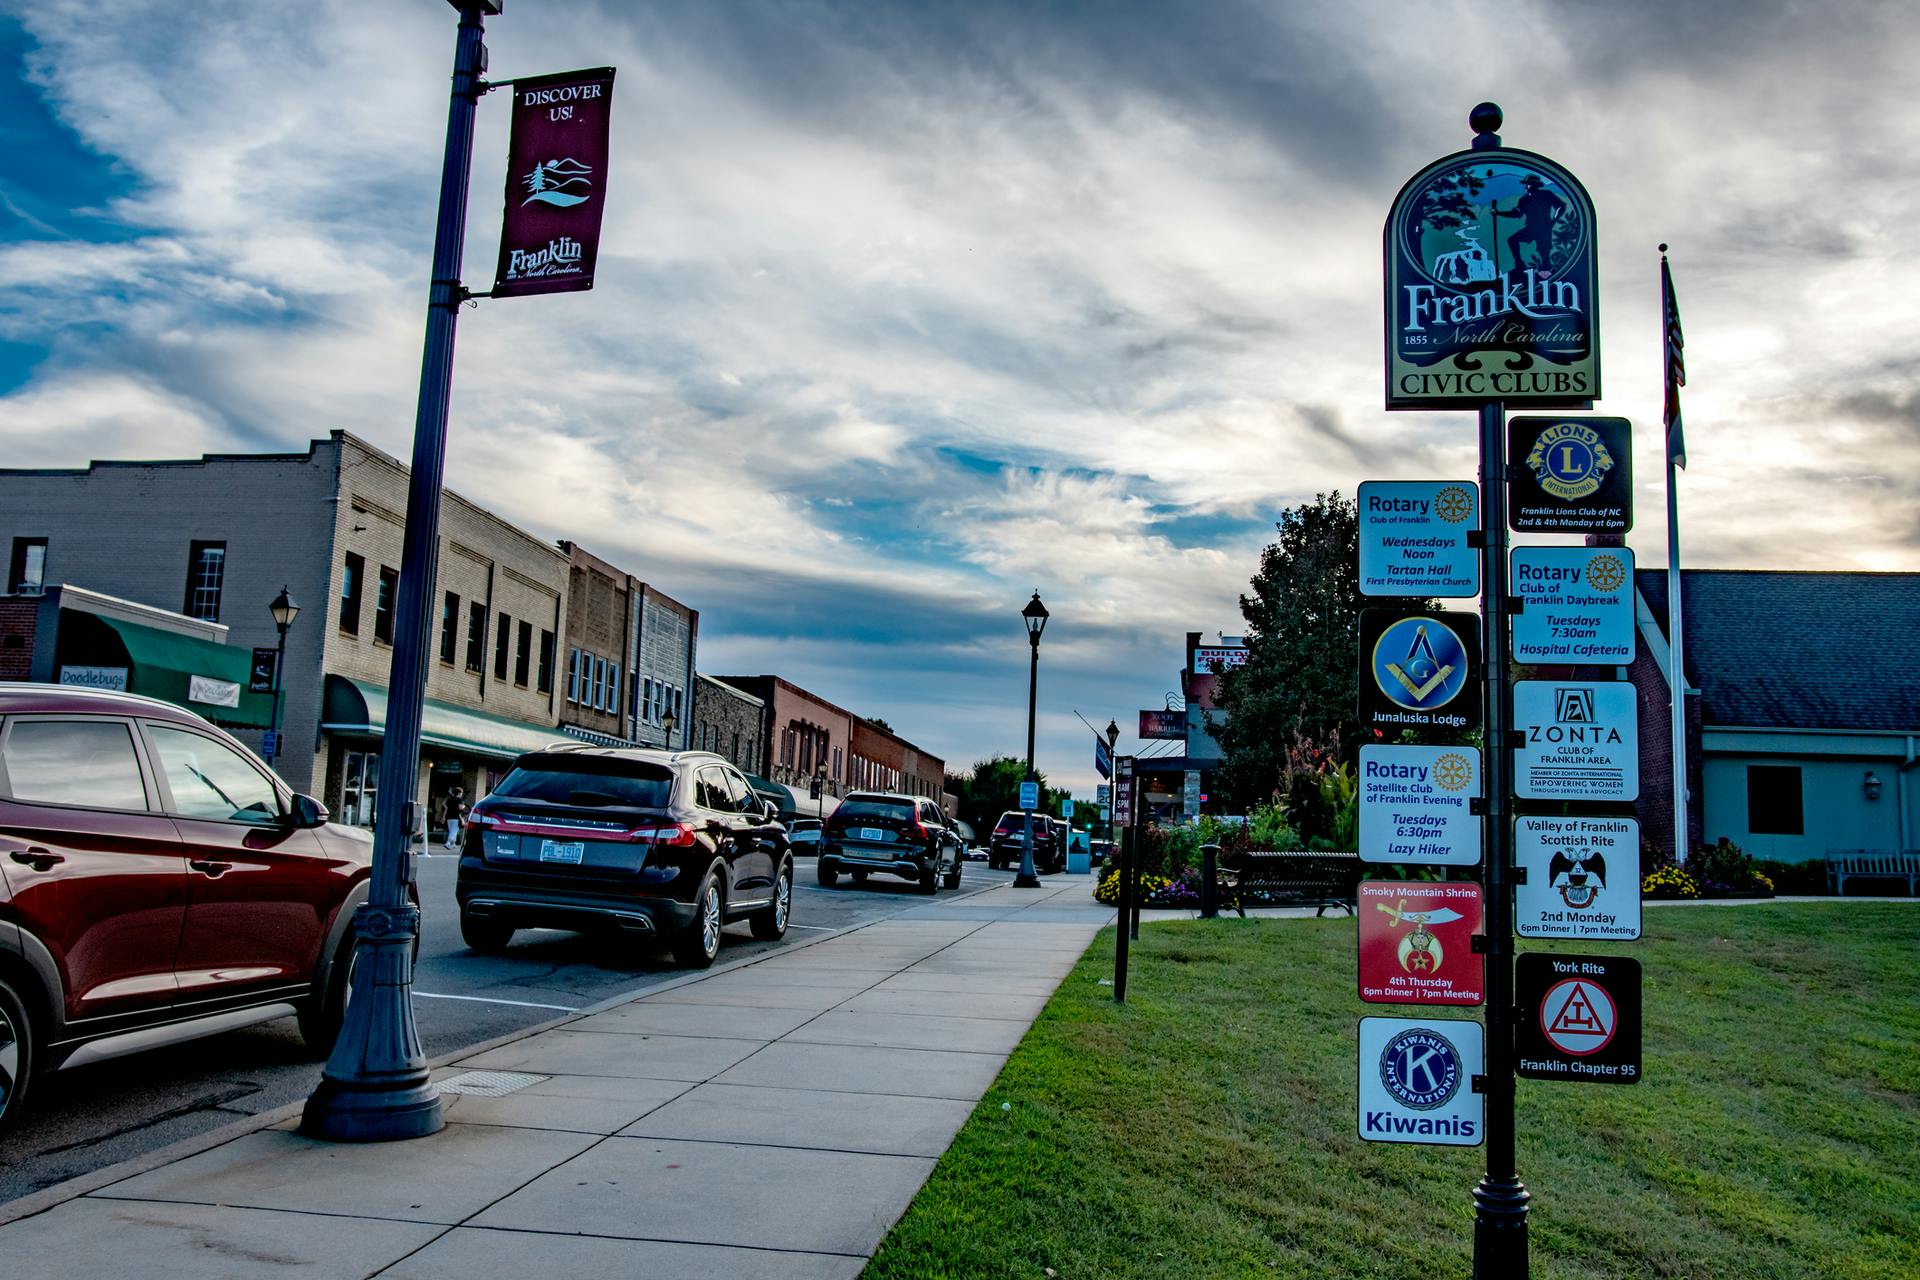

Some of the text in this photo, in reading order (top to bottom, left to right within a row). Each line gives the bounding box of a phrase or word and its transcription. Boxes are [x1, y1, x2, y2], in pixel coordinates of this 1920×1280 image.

[524, 84, 602, 106] DISCOVER
[550, 106, 574, 121] US!
[507, 236, 582, 274] Franklin
[518, 263, 550, 278] North
[546, 263, 582, 276] Carolina
[1404, 268, 1583, 332] Franklin
[1404, 320, 1584, 345] 1855 North Carolina
[1400, 372, 1587, 394] CIVIC CLUBS
[1545, 426, 1594, 442] LIONS
[1561, 447, 1582, 473] L
[1545, 480, 1594, 495] INTERNATIONAL
[1369, 496, 1430, 515] Rotary
[1579, 508, 1596, 516] Club
[1598, 508, 1608, 517] of
[1609, 508, 1621, 516] NC
[1370, 516, 1430, 524] Club of Franklin
[1518, 518, 1533, 526] 2nd
[1544, 518, 1558, 526] 4th
[1560, 519, 1594, 528] Monday
[1606, 520, 1625, 528] 6pm
[1382, 537, 1456, 549] Wednesdays
[1403, 550, 1434, 559] Noon
[1387, 565, 1452, 575] Tartan Hall
[1519, 564, 1581, 583] Rotary
[1387, 578, 1440, 586] Presbyterian
[1442, 578, 1471, 586] Church
[1520, 583, 1560, 593] Club of
[1520, 595, 1619, 606] ranklin Daybreak
[1547, 615, 1601, 628] Tuesdays
[1552, 628, 1596, 638] 7:30am
[1520, 644, 1628, 656] Hospital Cafeteria
[1411, 660, 1428, 678] G
[62, 670, 124, 689] Doodlebugs
[1373, 712, 1466, 727] Junaluska Lodge
[1529, 726, 1622, 744] ZONTA
[1558, 747, 1580, 755] CLUB
[1541, 756, 1585, 764] FRANKLIN
[1366, 761, 1428, 782] Rotary
[1118, 783, 1130, 792] 8AM
[1367, 783, 1432, 793] Satellite Club
[1530, 780, 1587, 788] EMPOWERING
[1117, 800, 1129, 808] 5PM
[1367, 794, 1462, 807] of Franklin Evening
[1393, 814, 1447, 828] Tuesdays
[1527, 820, 1628, 833] Valley of Franklin
[1397, 827, 1442, 839] 6:30pm
[1541, 835, 1614, 846] Scottish Rite
[1388, 843, 1451, 856] Lazy Hiker
[1363, 887, 1477, 898] Smoky Mountain Shrine
[1541, 912, 1616, 925] 2nd Monday
[1521, 924, 1540, 932] 6pm
[1542, 924, 1570, 932] Dinner
[1580, 926, 1598, 934] 7pm
[1601, 926, 1636, 936] Meeting
[1552, 961, 1605, 974] York Rite
[1389, 977, 1452, 989] 4th Thursday
[1364, 987, 1382, 996] 6pm
[1385, 988, 1413, 996] Dinner
[1422, 989, 1441, 998] 7pm
[1444, 990, 1480, 1000] Meeting
[1395, 1036, 1448, 1055] KIWANIS
[1405, 1046, 1439, 1092] K
[1520, 1059, 1635, 1076] Franklin Chapter 95
[1387, 1061, 1455, 1103] INTERNATIONAL
[1367, 1112, 1475, 1136] Kiwanis
